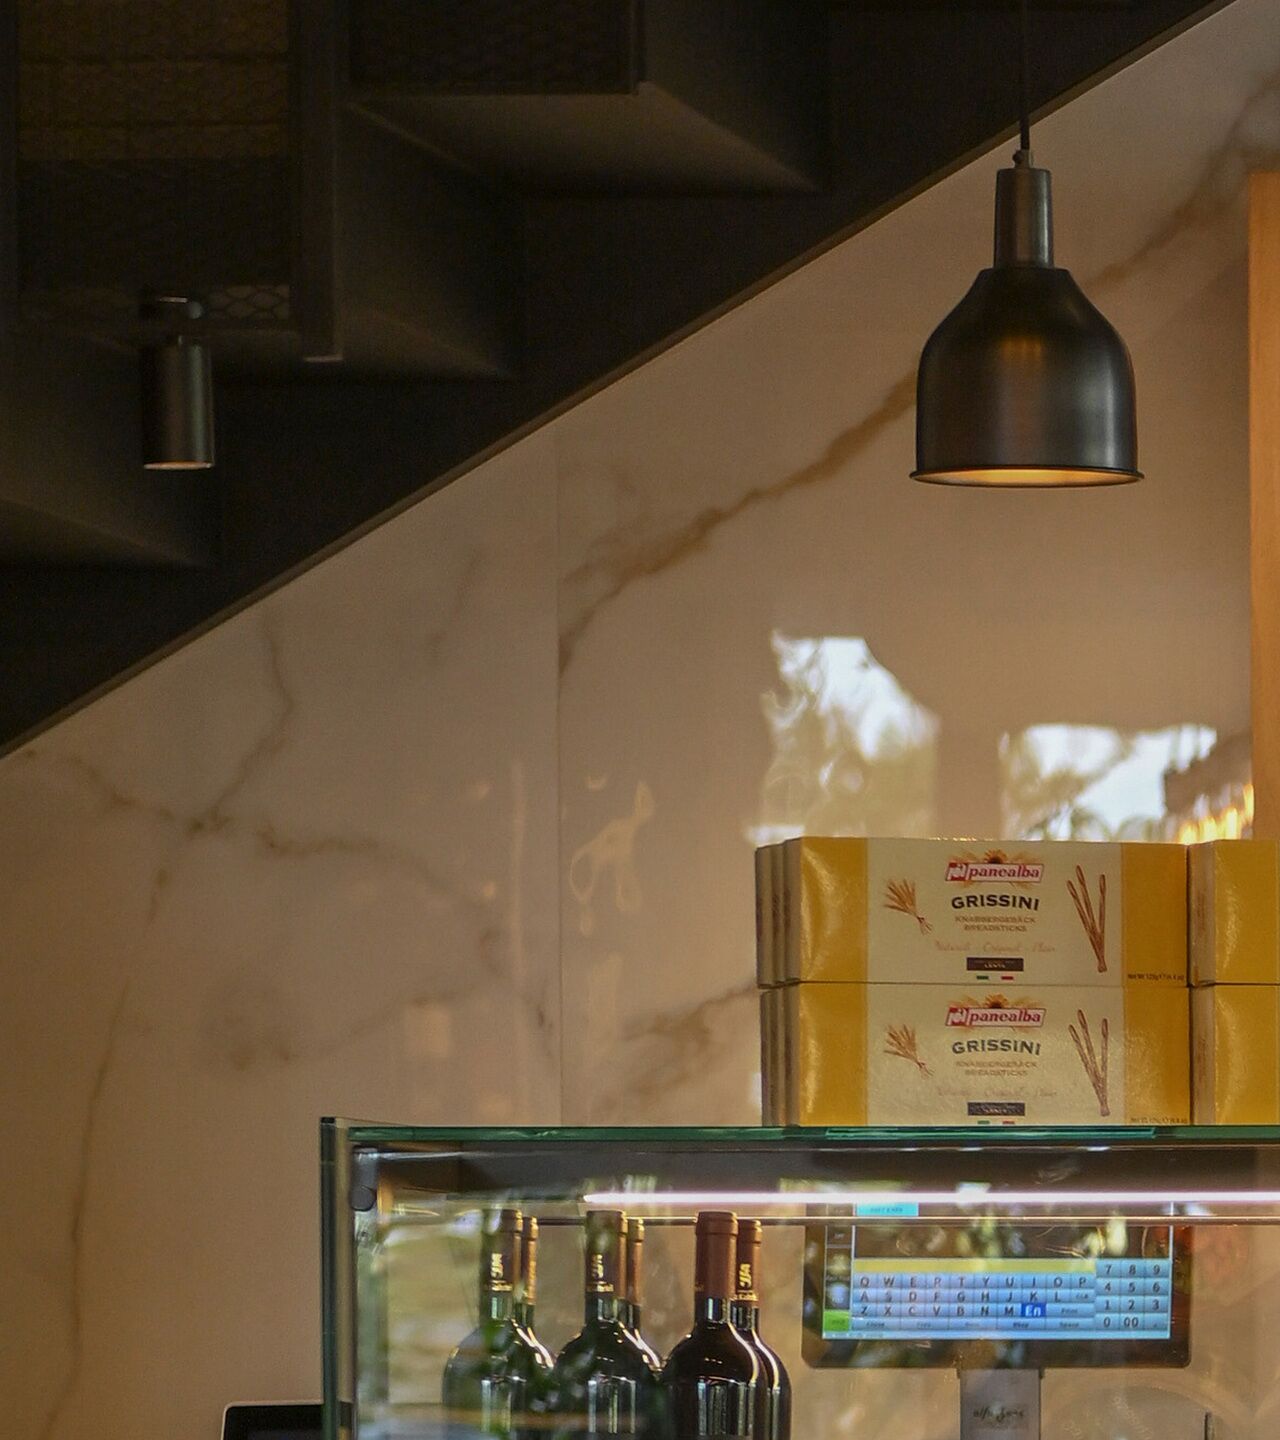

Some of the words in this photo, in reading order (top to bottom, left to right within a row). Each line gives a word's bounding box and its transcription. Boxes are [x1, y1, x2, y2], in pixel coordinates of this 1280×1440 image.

[968, 863, 1041, 880] panealba
[951, 894, 1040, 911] GRISSINI
[968, 1007, 1042, 1024] panealba
[951, 1039, 1042, 1056] GRISSINI
[1025, 1304, 1042, 1317] En
[1123, 1316, 1139, 1327] 00
